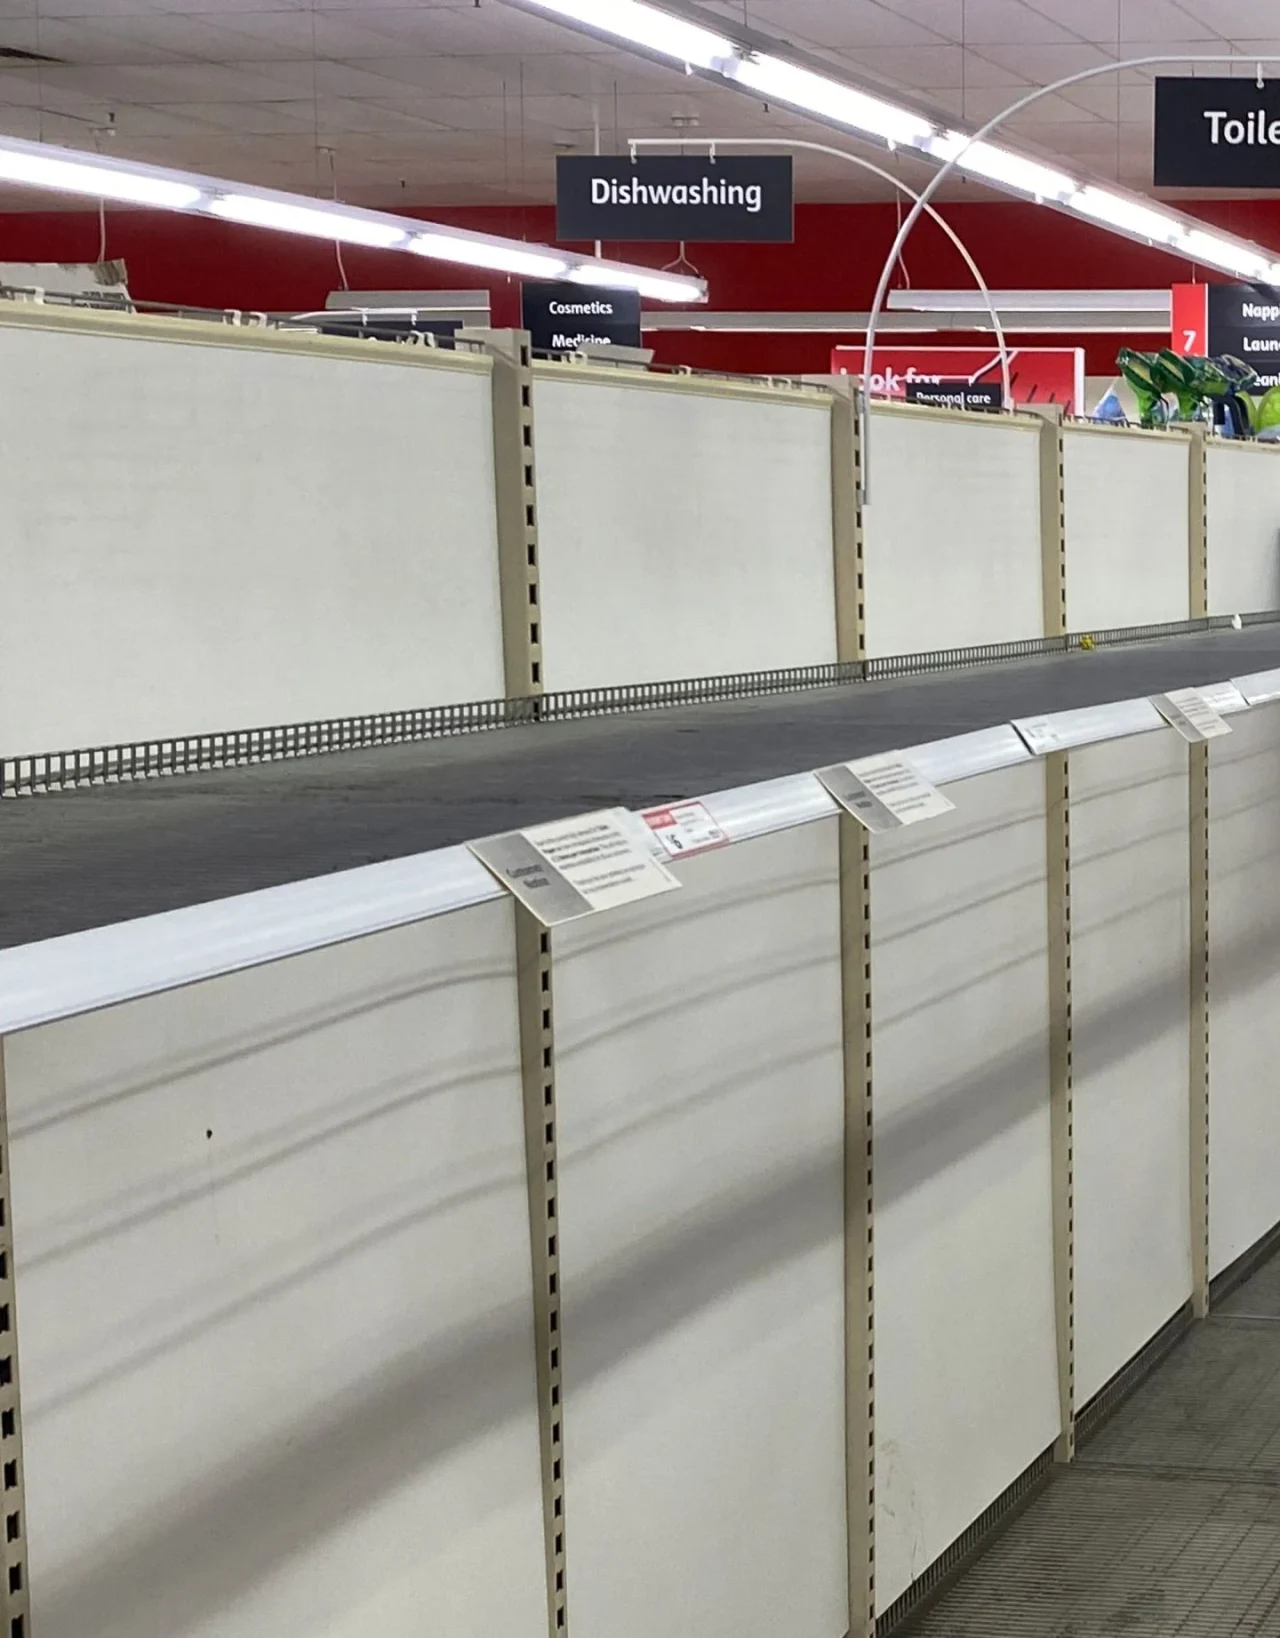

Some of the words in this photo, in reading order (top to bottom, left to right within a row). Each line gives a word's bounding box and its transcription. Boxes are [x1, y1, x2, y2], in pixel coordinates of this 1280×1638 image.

[590, 176, 763, 213] Dishwashing
[549, 301, 613, 315] Cosmetics
[1183, 330, 1197, 352] 7
[966, 394, 992, 404] care
